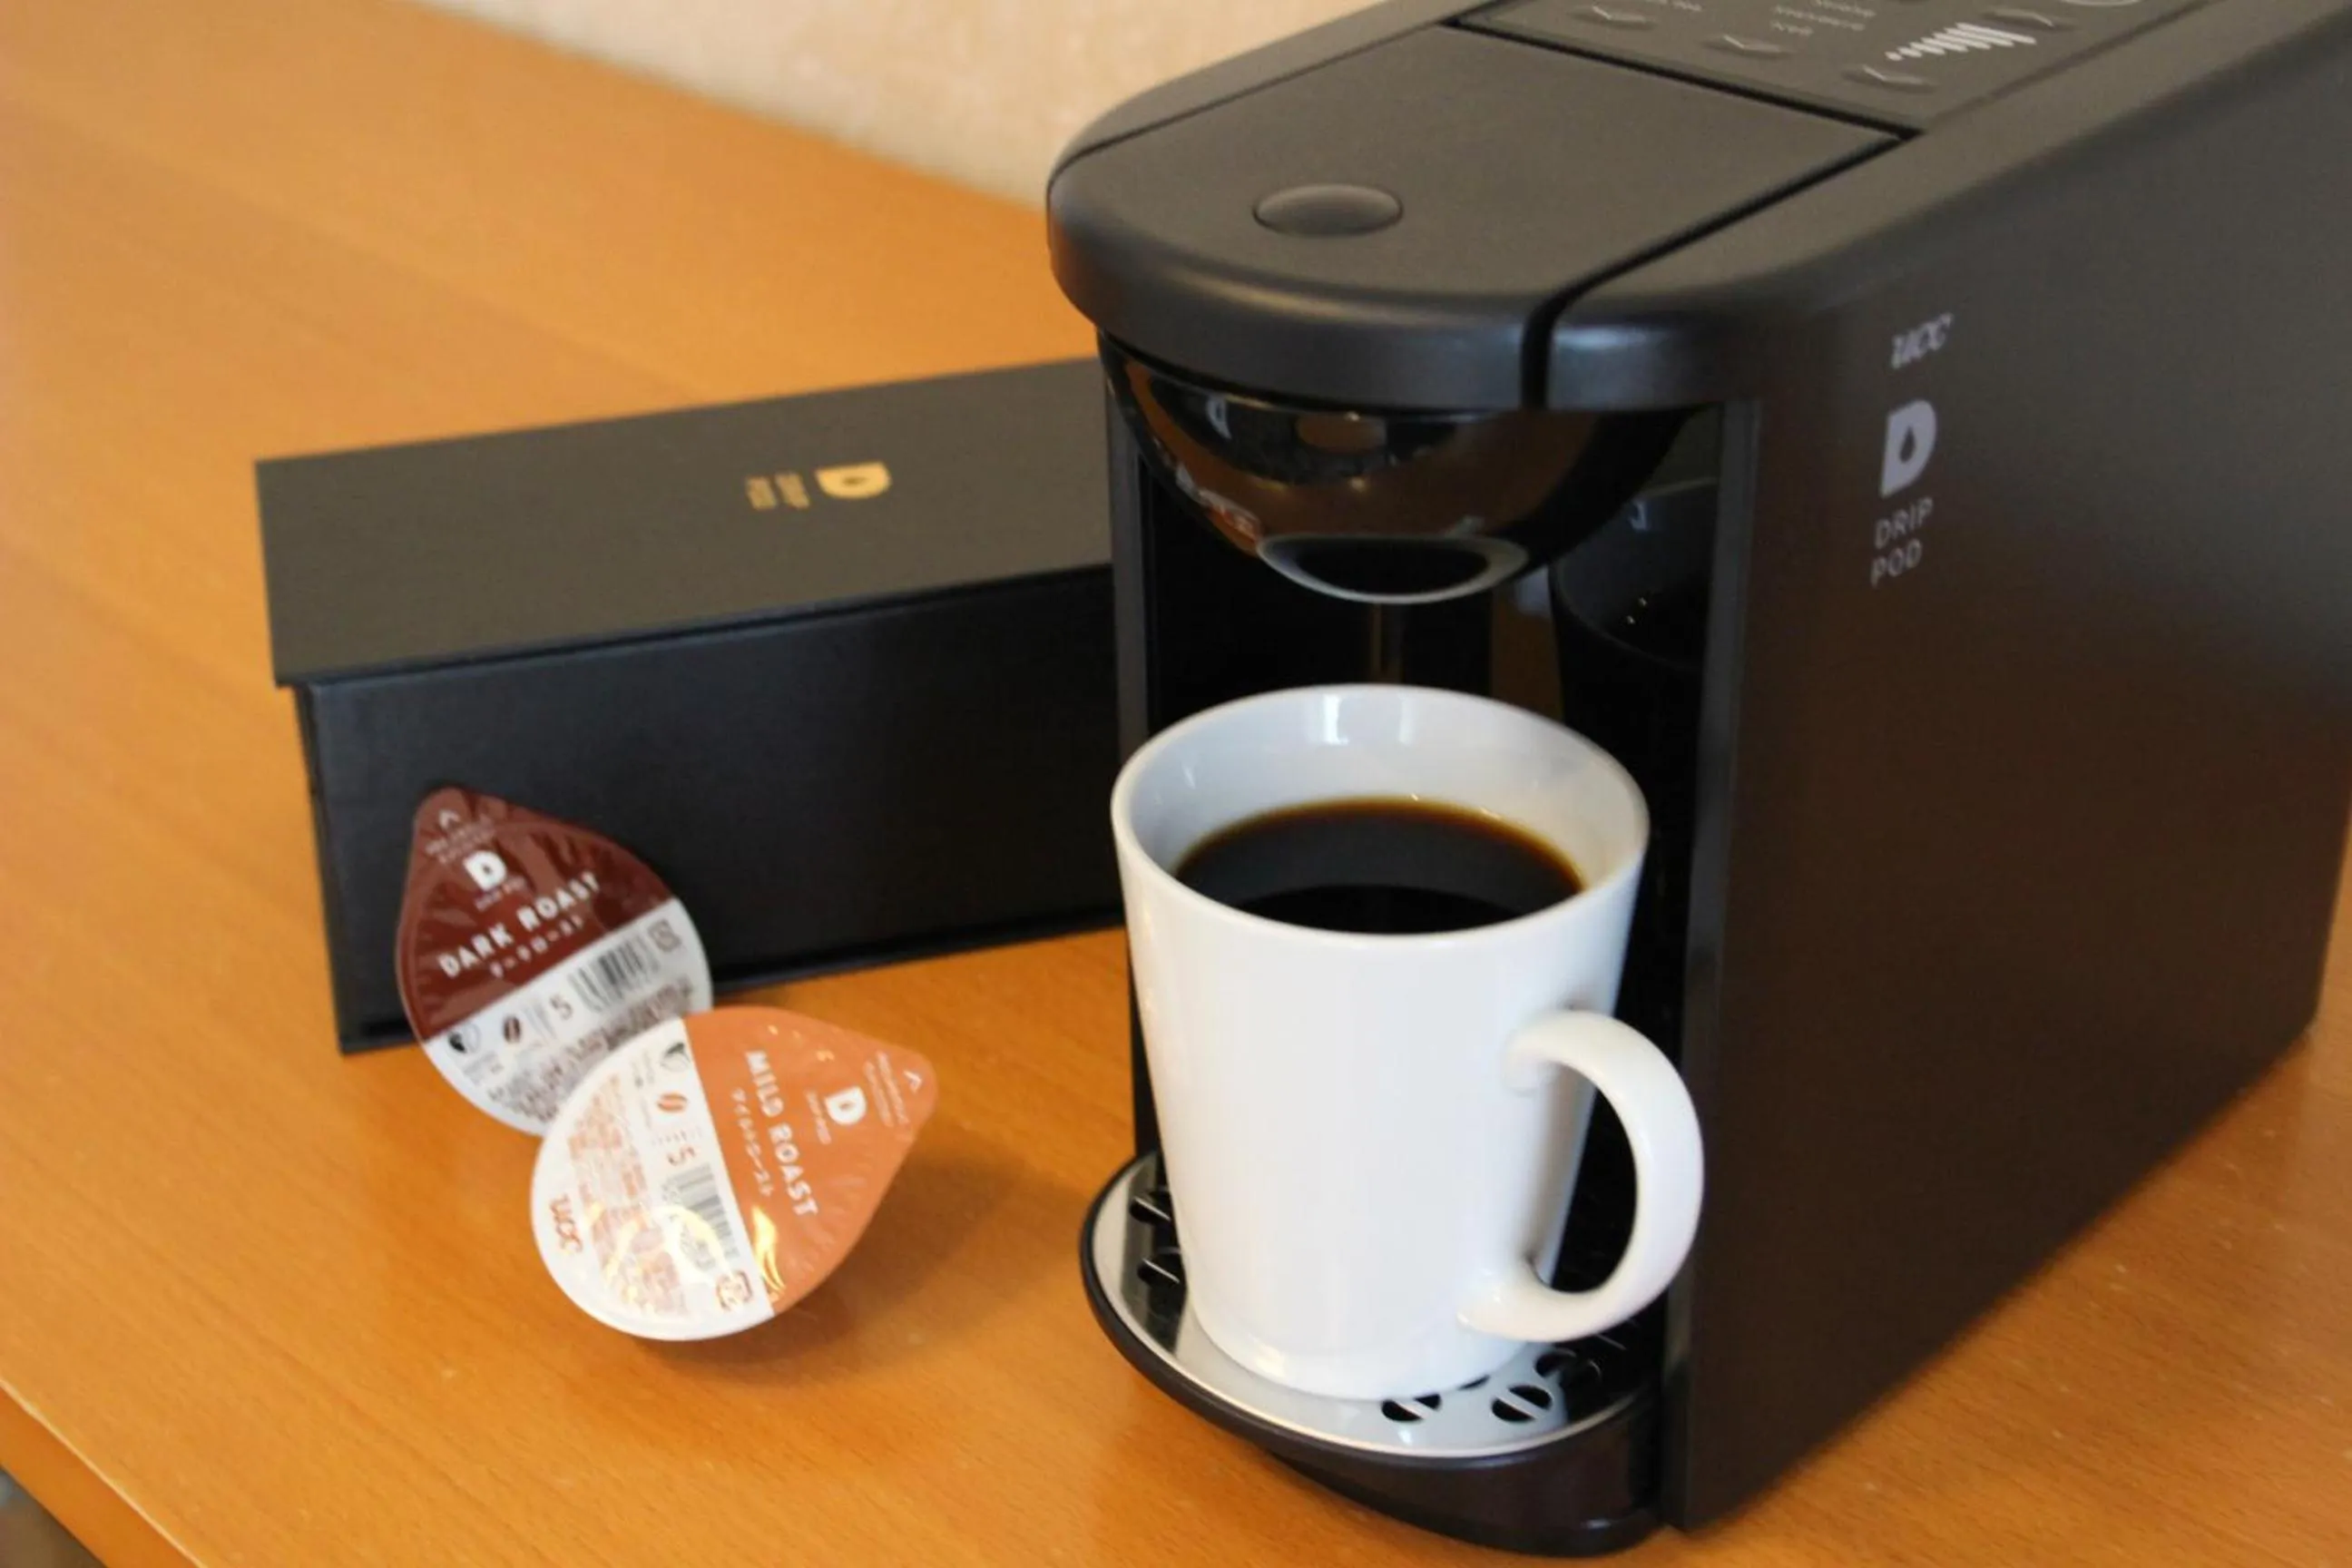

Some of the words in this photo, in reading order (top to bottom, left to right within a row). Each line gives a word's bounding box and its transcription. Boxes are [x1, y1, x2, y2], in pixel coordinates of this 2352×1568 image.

[1880, 399, 1937, 498] D
[1870, 538, 1923, 588] POD
[1875, 496, 1934, 550] DRIP
[436, 924, 514, 977] DARK
[516, 870, 600, 931] ROAST
[744, 1051, 784, 1117] MILD
[769, 1122, 819, 1216] ROAST
